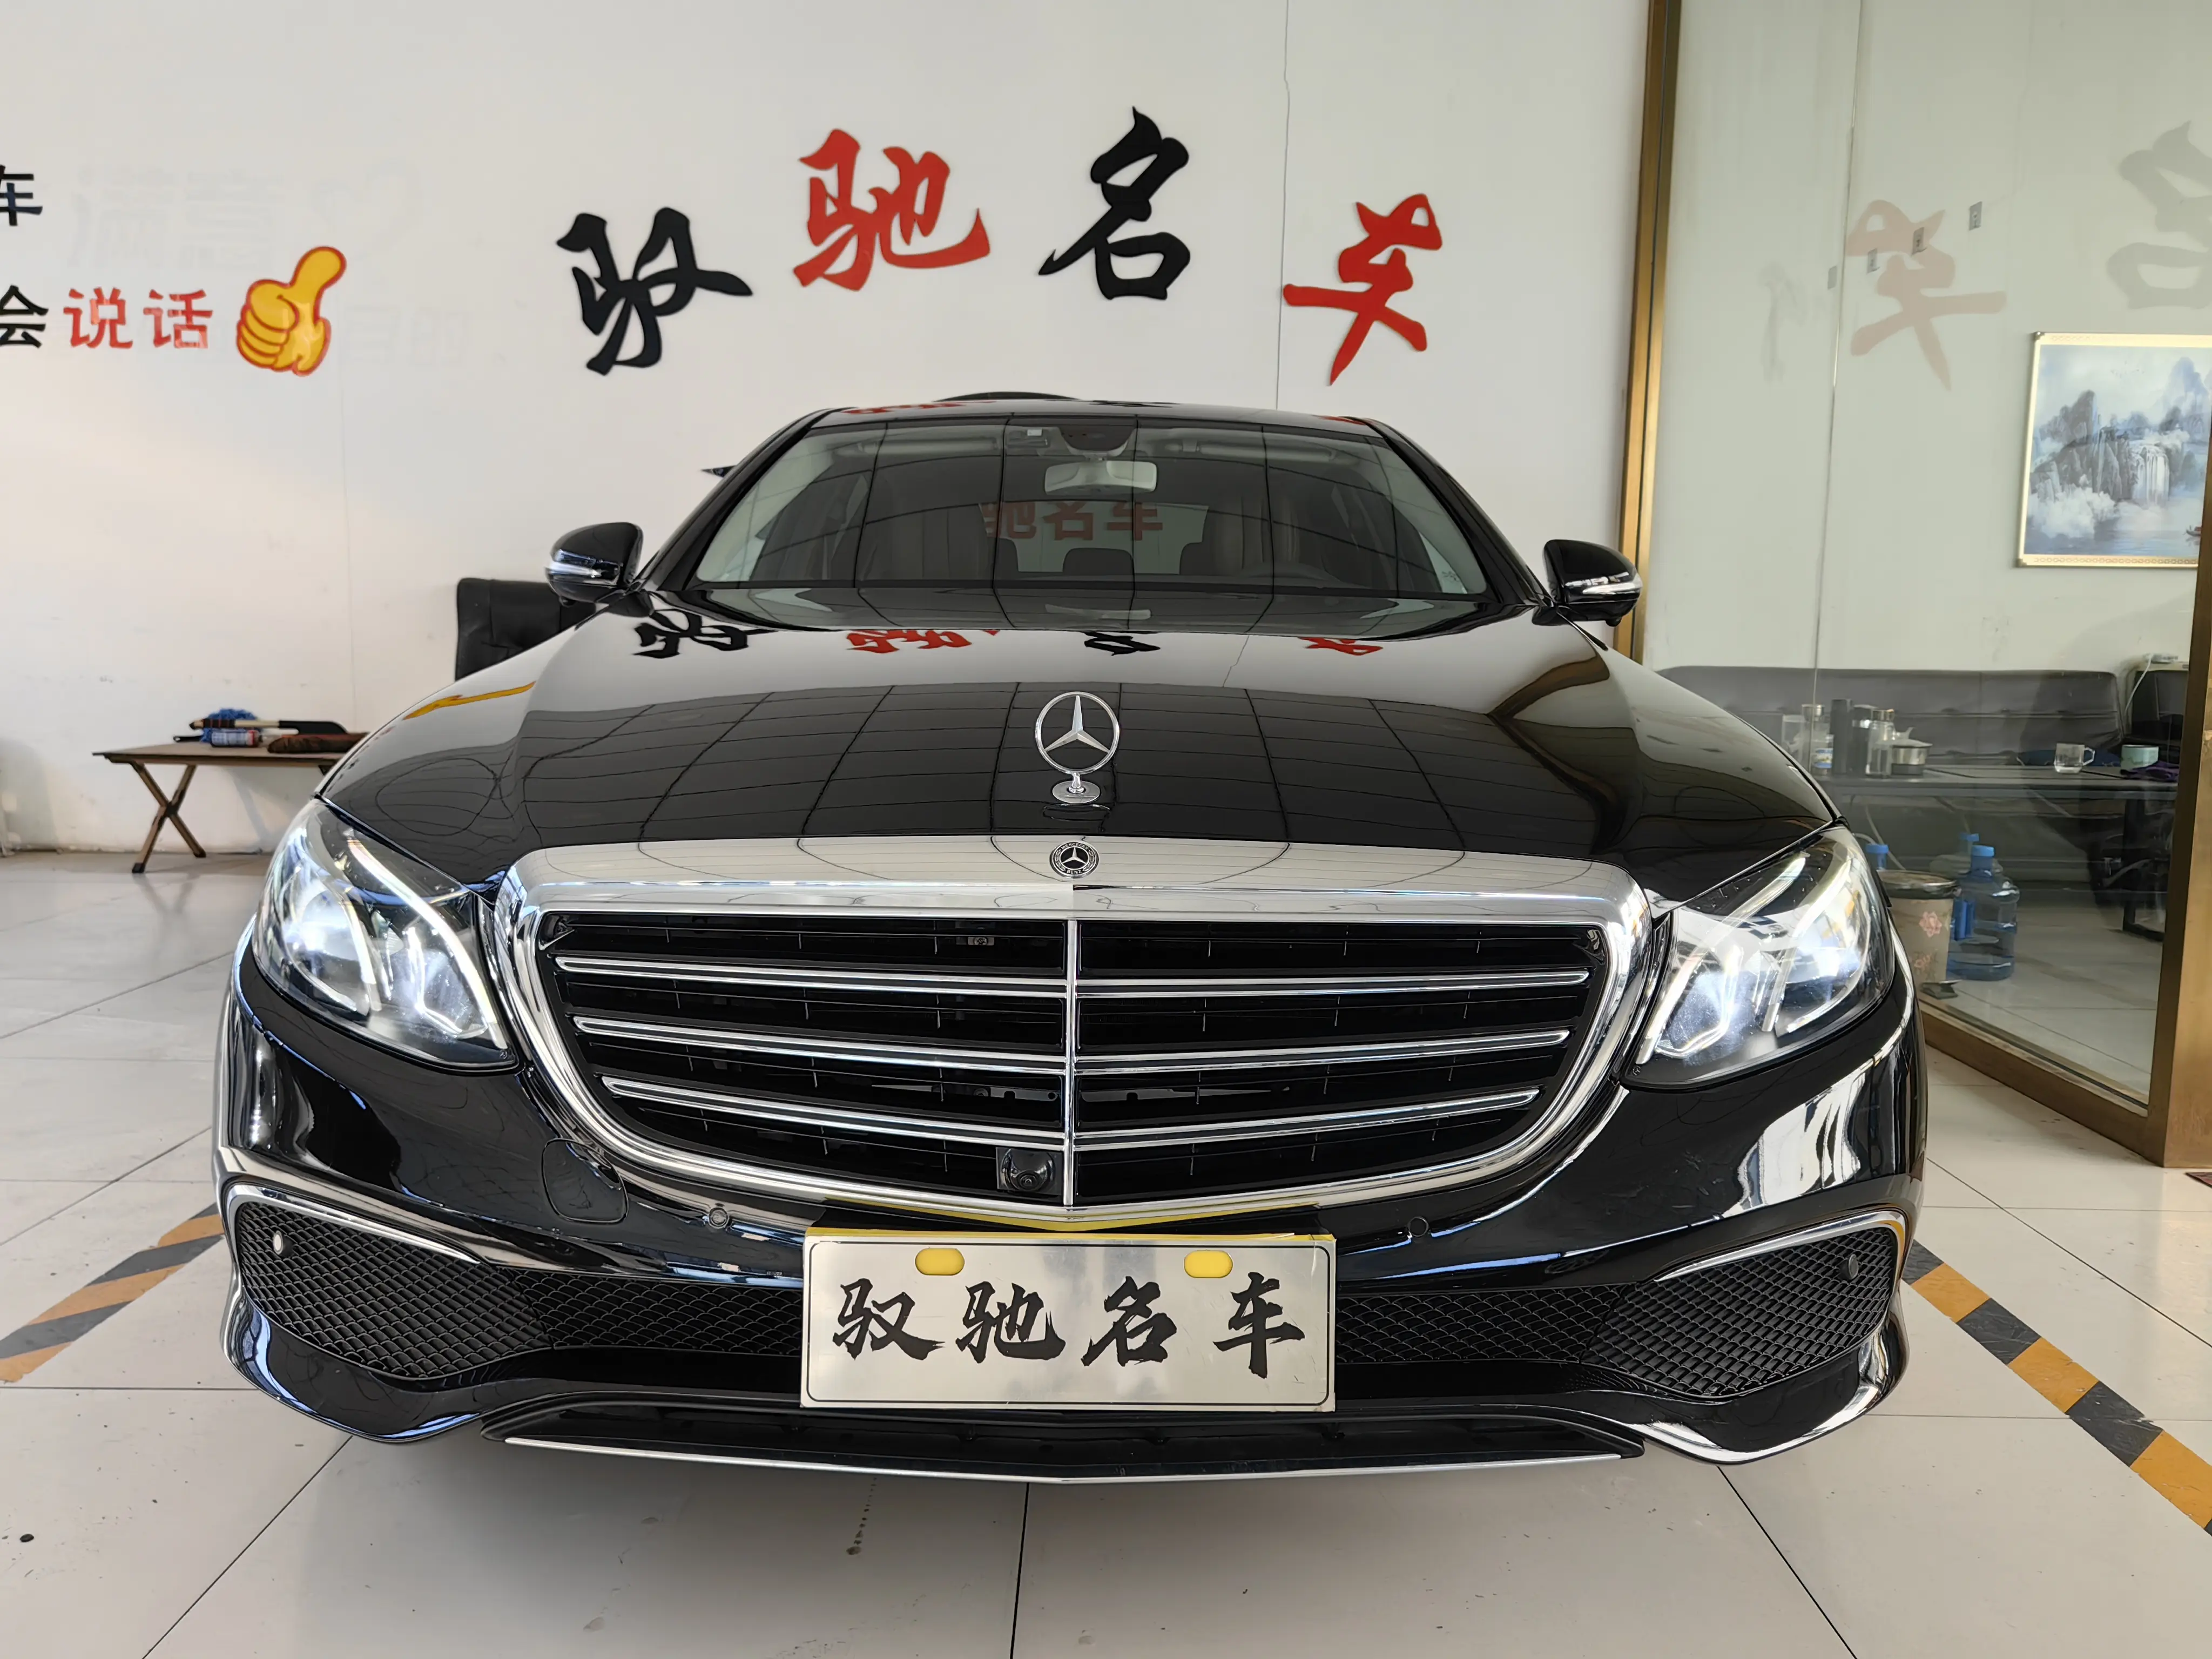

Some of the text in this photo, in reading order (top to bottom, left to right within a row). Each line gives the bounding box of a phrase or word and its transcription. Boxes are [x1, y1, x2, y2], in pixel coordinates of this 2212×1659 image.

[556, 105, 1443, 385] 驭驰名车
[832, 1271, 1306, 1379] 驭驰名车
